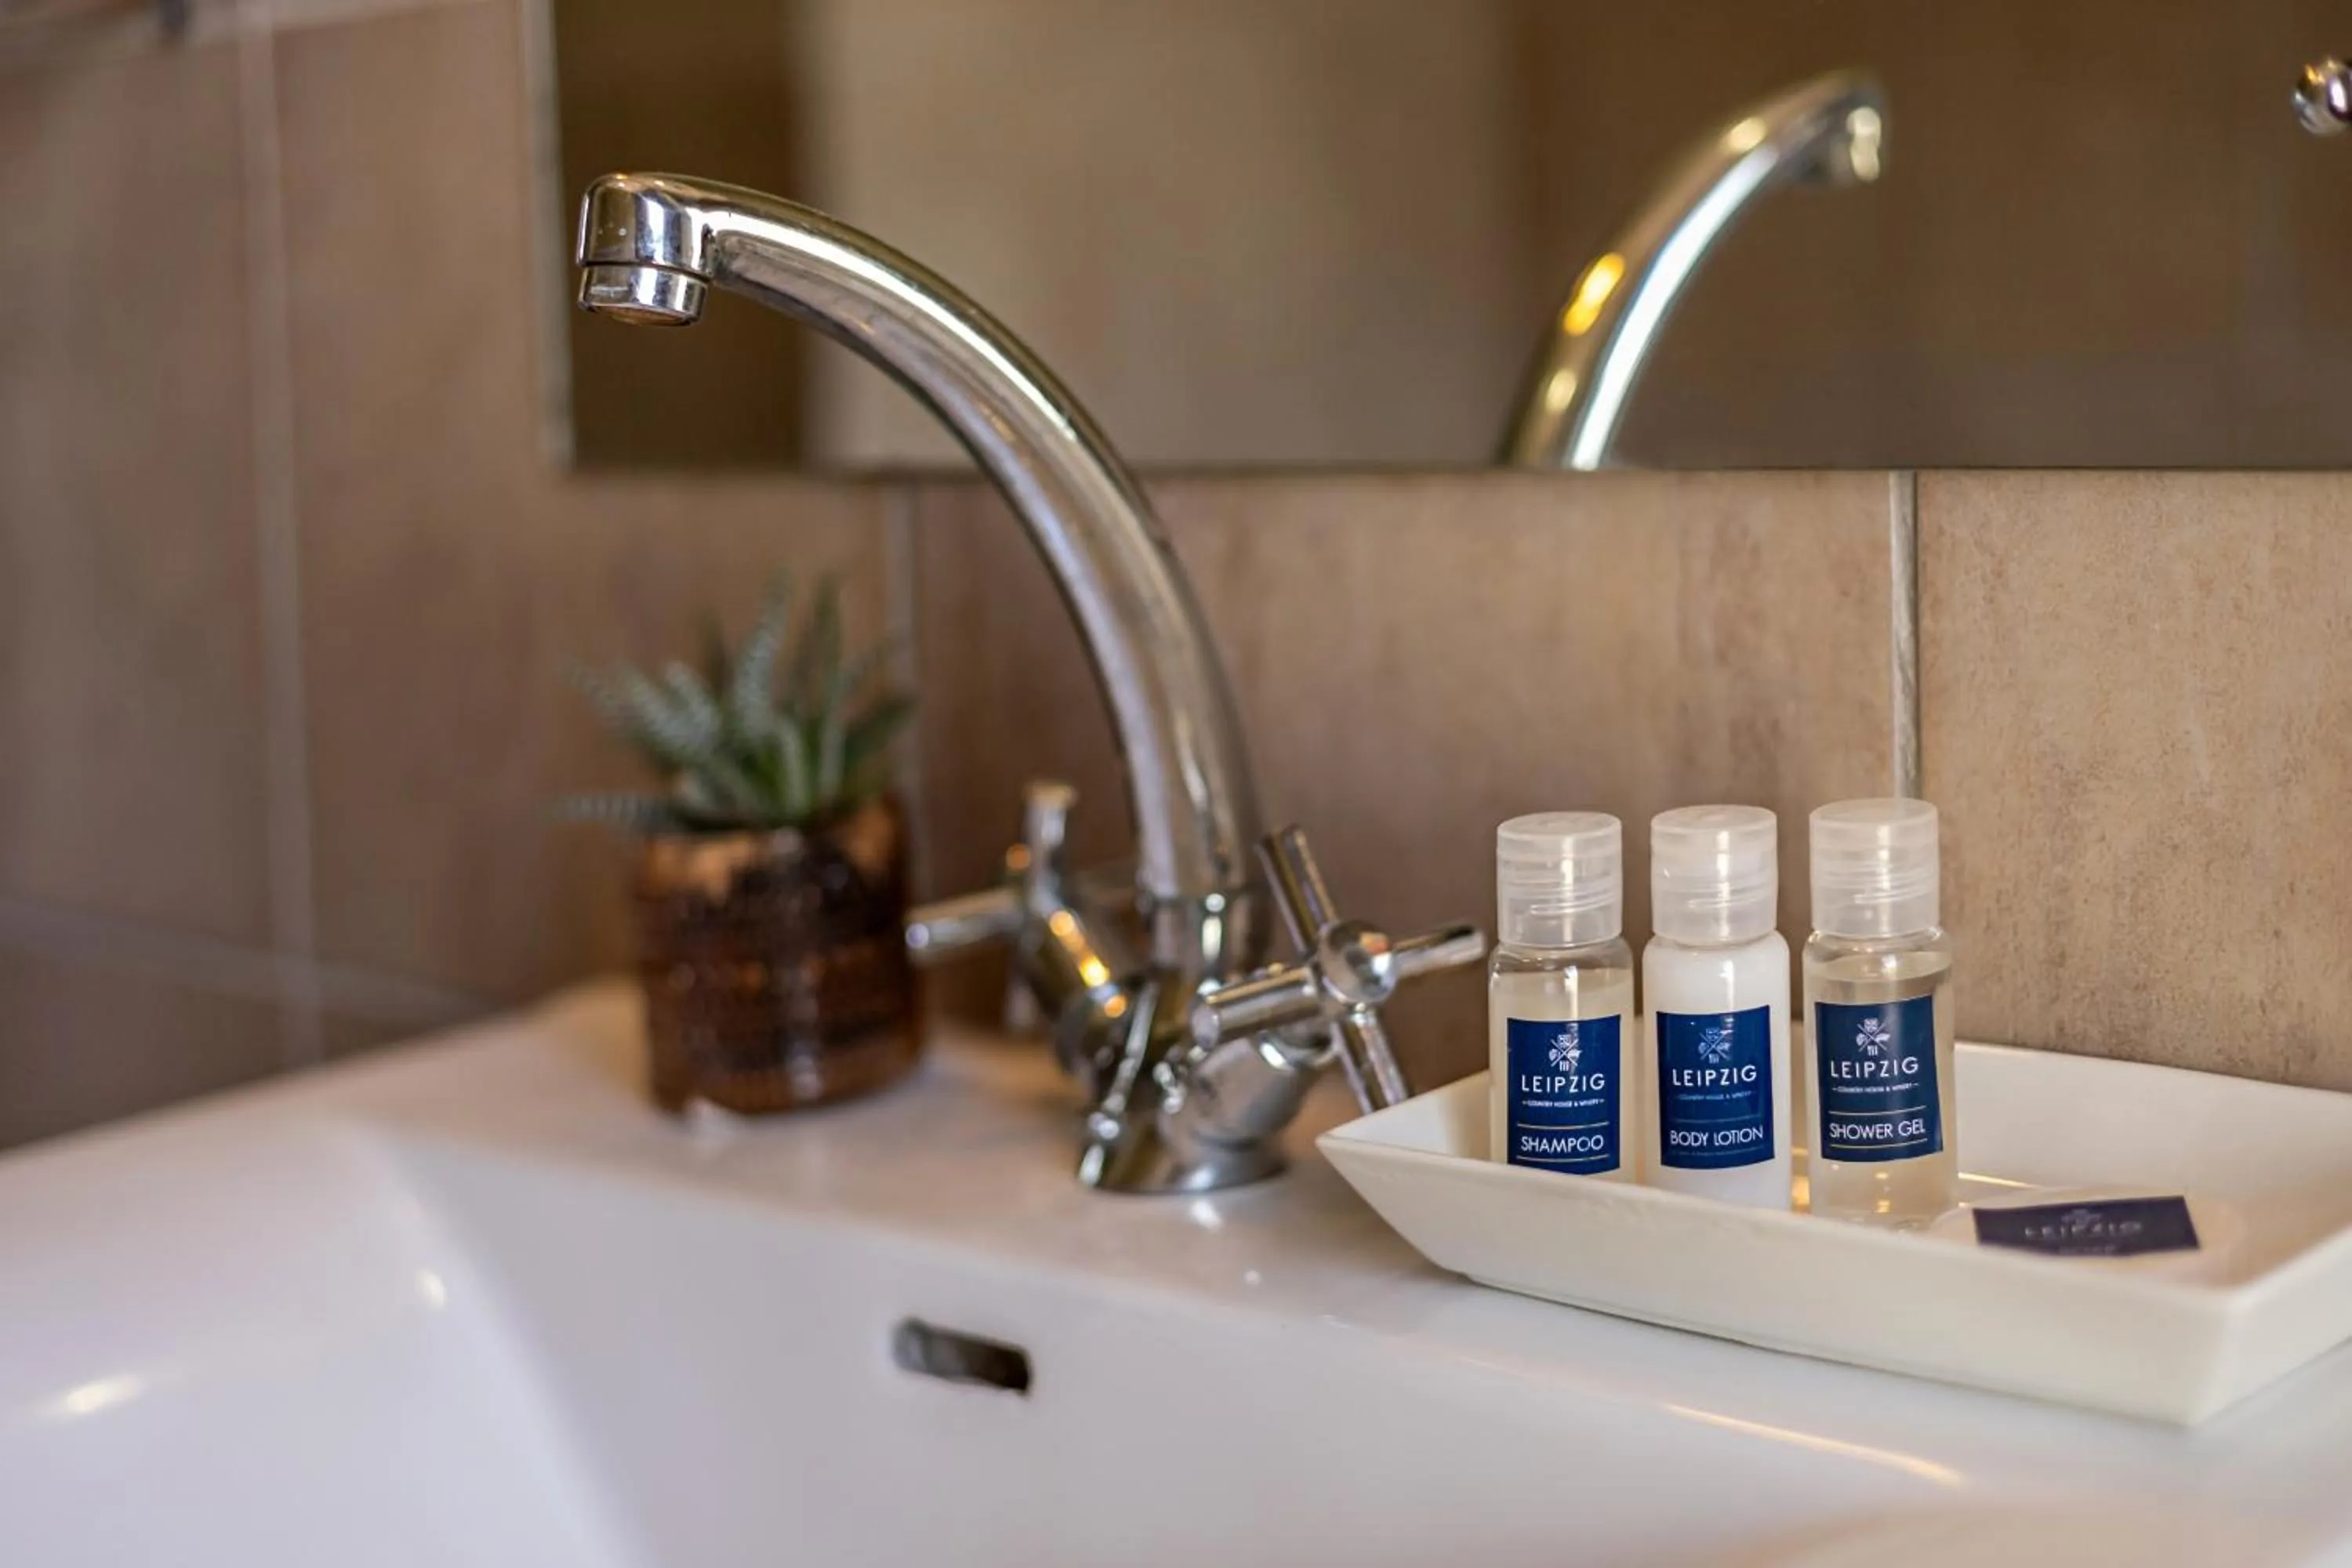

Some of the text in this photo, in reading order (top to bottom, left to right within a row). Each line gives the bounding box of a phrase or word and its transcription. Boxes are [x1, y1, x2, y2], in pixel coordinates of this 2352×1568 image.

[1672, 1065, 1757, 1087] LEIPZIG
[1831, 1057, 1919, 1079] LEIPZIG
[1521, 1073, 1606, 1094] LEIPZIG
[1670, 1124, 1764, 1147] BODY LOTION
[1829, 1118, 1926, 1140] SHOWER GEL
[1520, 1134, 1604, 1154] SHAMPOO
